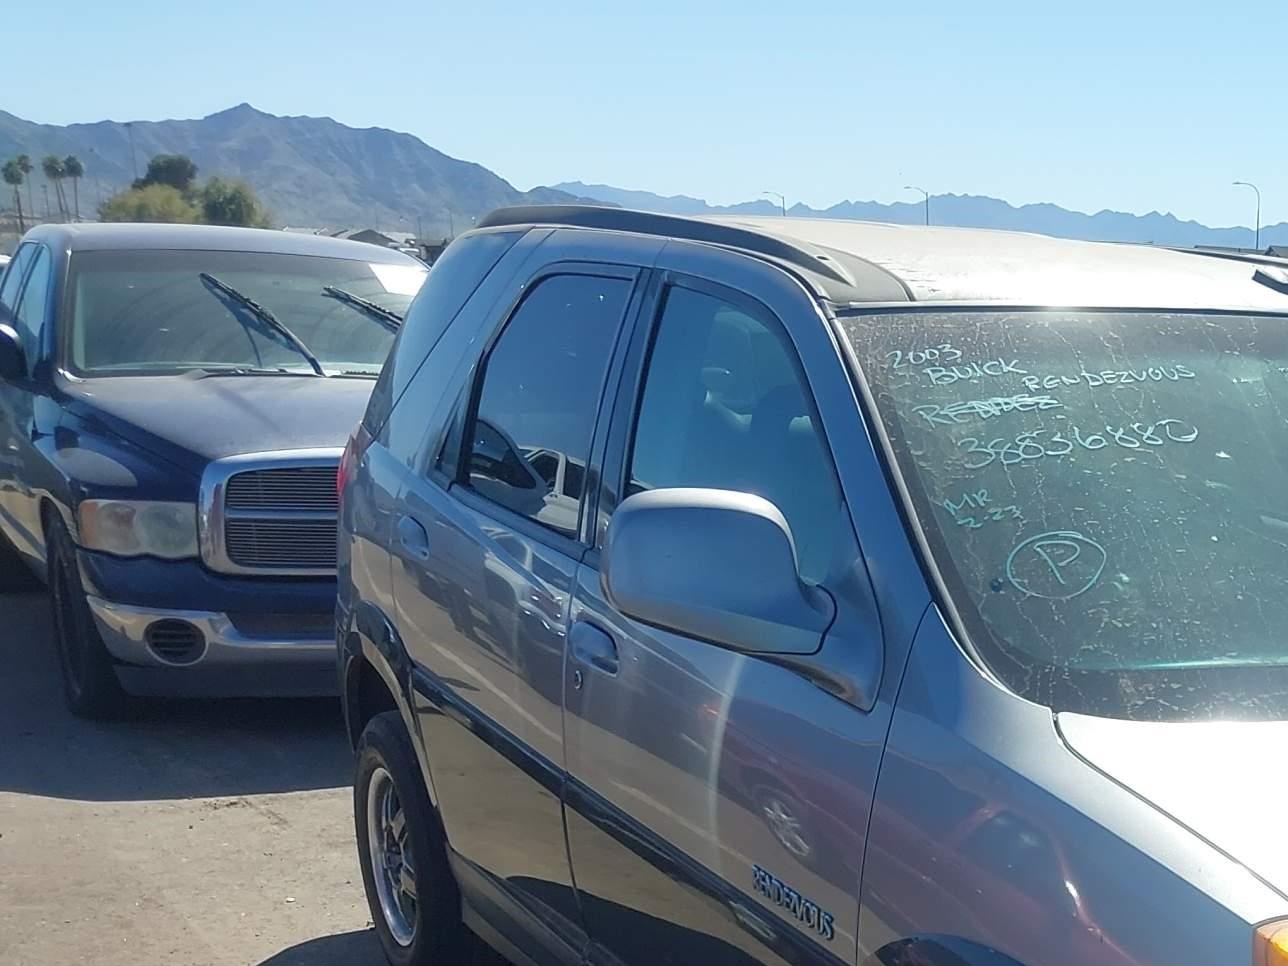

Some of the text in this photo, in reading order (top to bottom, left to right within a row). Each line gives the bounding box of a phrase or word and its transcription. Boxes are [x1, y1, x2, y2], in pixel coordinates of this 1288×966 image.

[887, 344, 962, 369] 2003
[923, 358, 1196, 391] BUICK RENDEZVOUS
[957, 418, 1198, 469] 38836880
[752, 864, 834, 940] RENDEZVOUS
